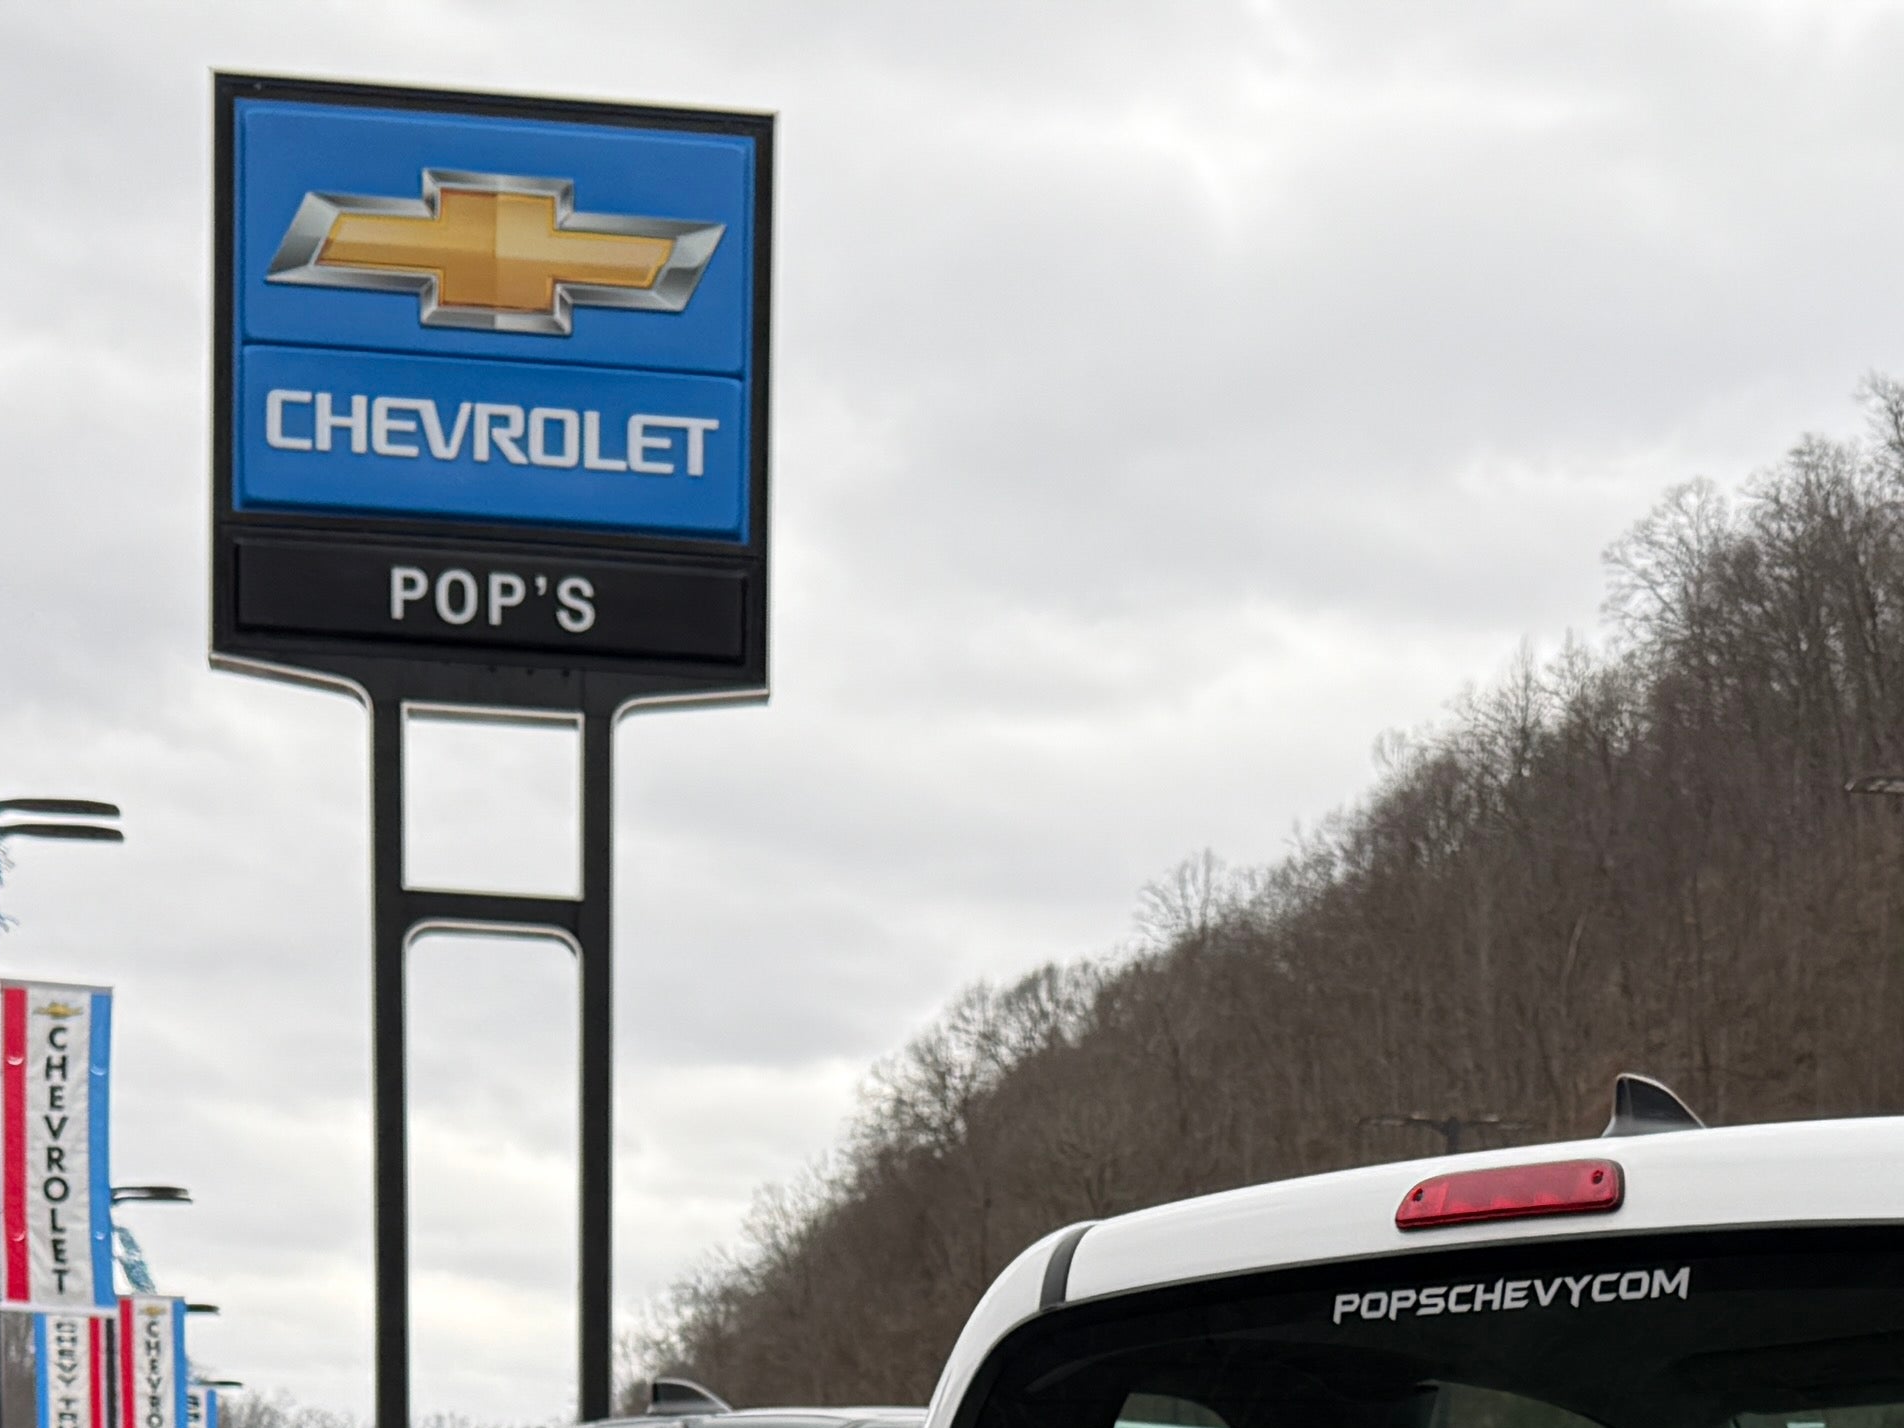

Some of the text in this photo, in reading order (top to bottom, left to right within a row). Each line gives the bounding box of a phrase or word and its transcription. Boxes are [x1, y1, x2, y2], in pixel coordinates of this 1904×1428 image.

[265, 388, 720, 477] CHEVROLET
[389, 566, 597, 633] POP'S
[42, 1026, 72, 1296] CHEVROLET
